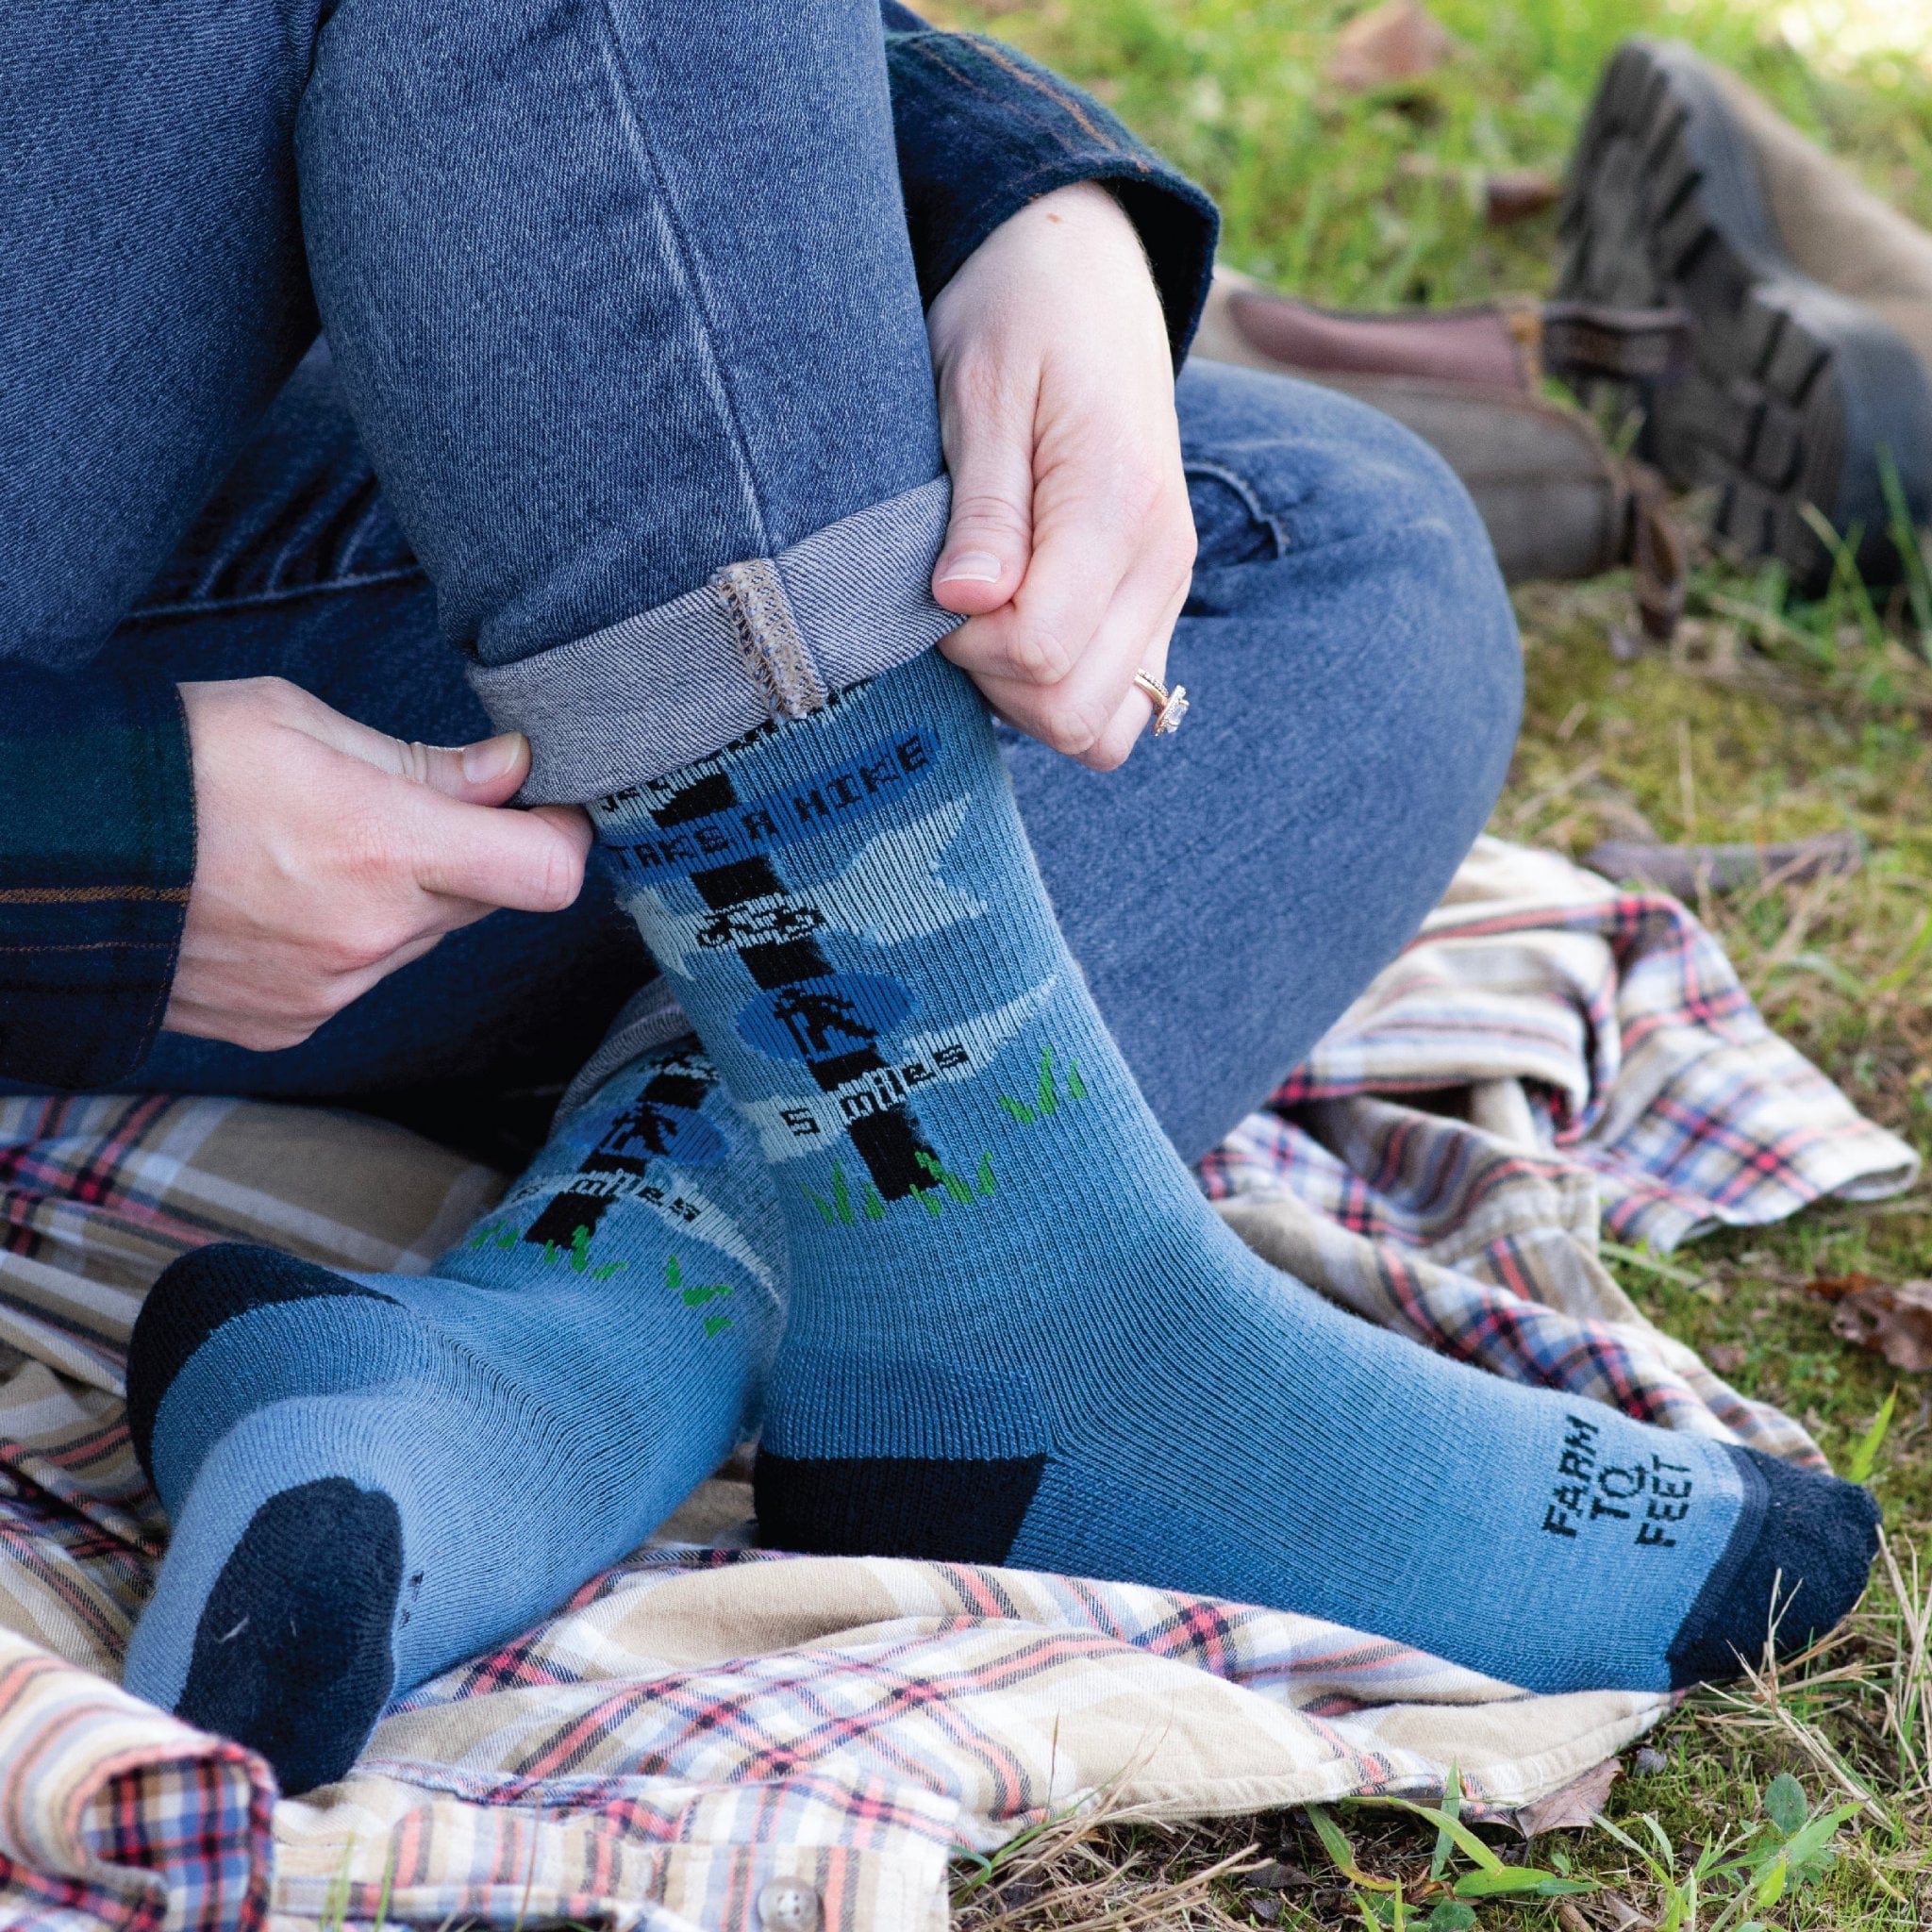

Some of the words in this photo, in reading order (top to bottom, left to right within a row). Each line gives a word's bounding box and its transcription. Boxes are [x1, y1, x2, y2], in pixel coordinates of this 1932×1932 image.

[607, 823, 730, 871] TAKE
[741, 808, 779, 841] A
[794, 734, 928, 822] HIKE
[839, 1043, 970, 1122] miles
[1541, 1414, 1599, 1539] FARM
[1590, 1463, 1649, 1520] TO
[1634, 1452, 1692, 1548] FEET
